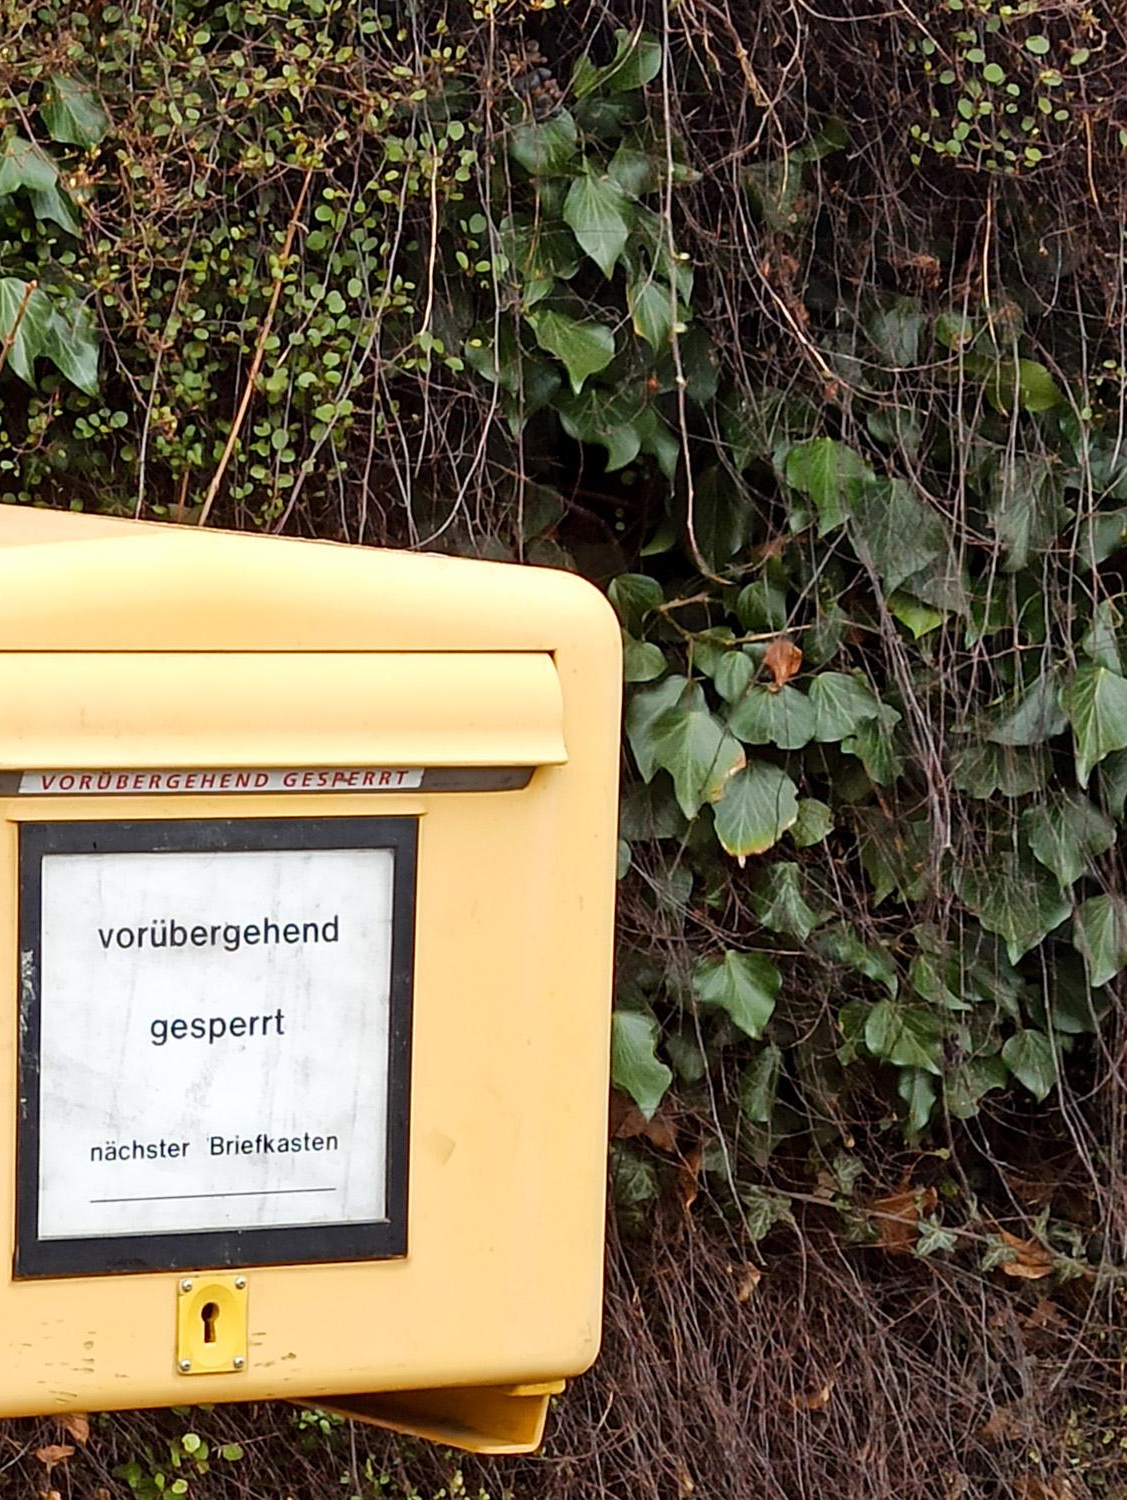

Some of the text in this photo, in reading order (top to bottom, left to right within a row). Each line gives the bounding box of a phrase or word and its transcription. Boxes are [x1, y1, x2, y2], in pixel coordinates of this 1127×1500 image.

[41, 769, 409, 790] VORÜBERGEHEND GESPERRT
[98, 914, 339, 951] vorübergehend
[150, 1008, 285, 1046] gesperrt
[90, 1132, 338, 1161] nächster Briefkasten
